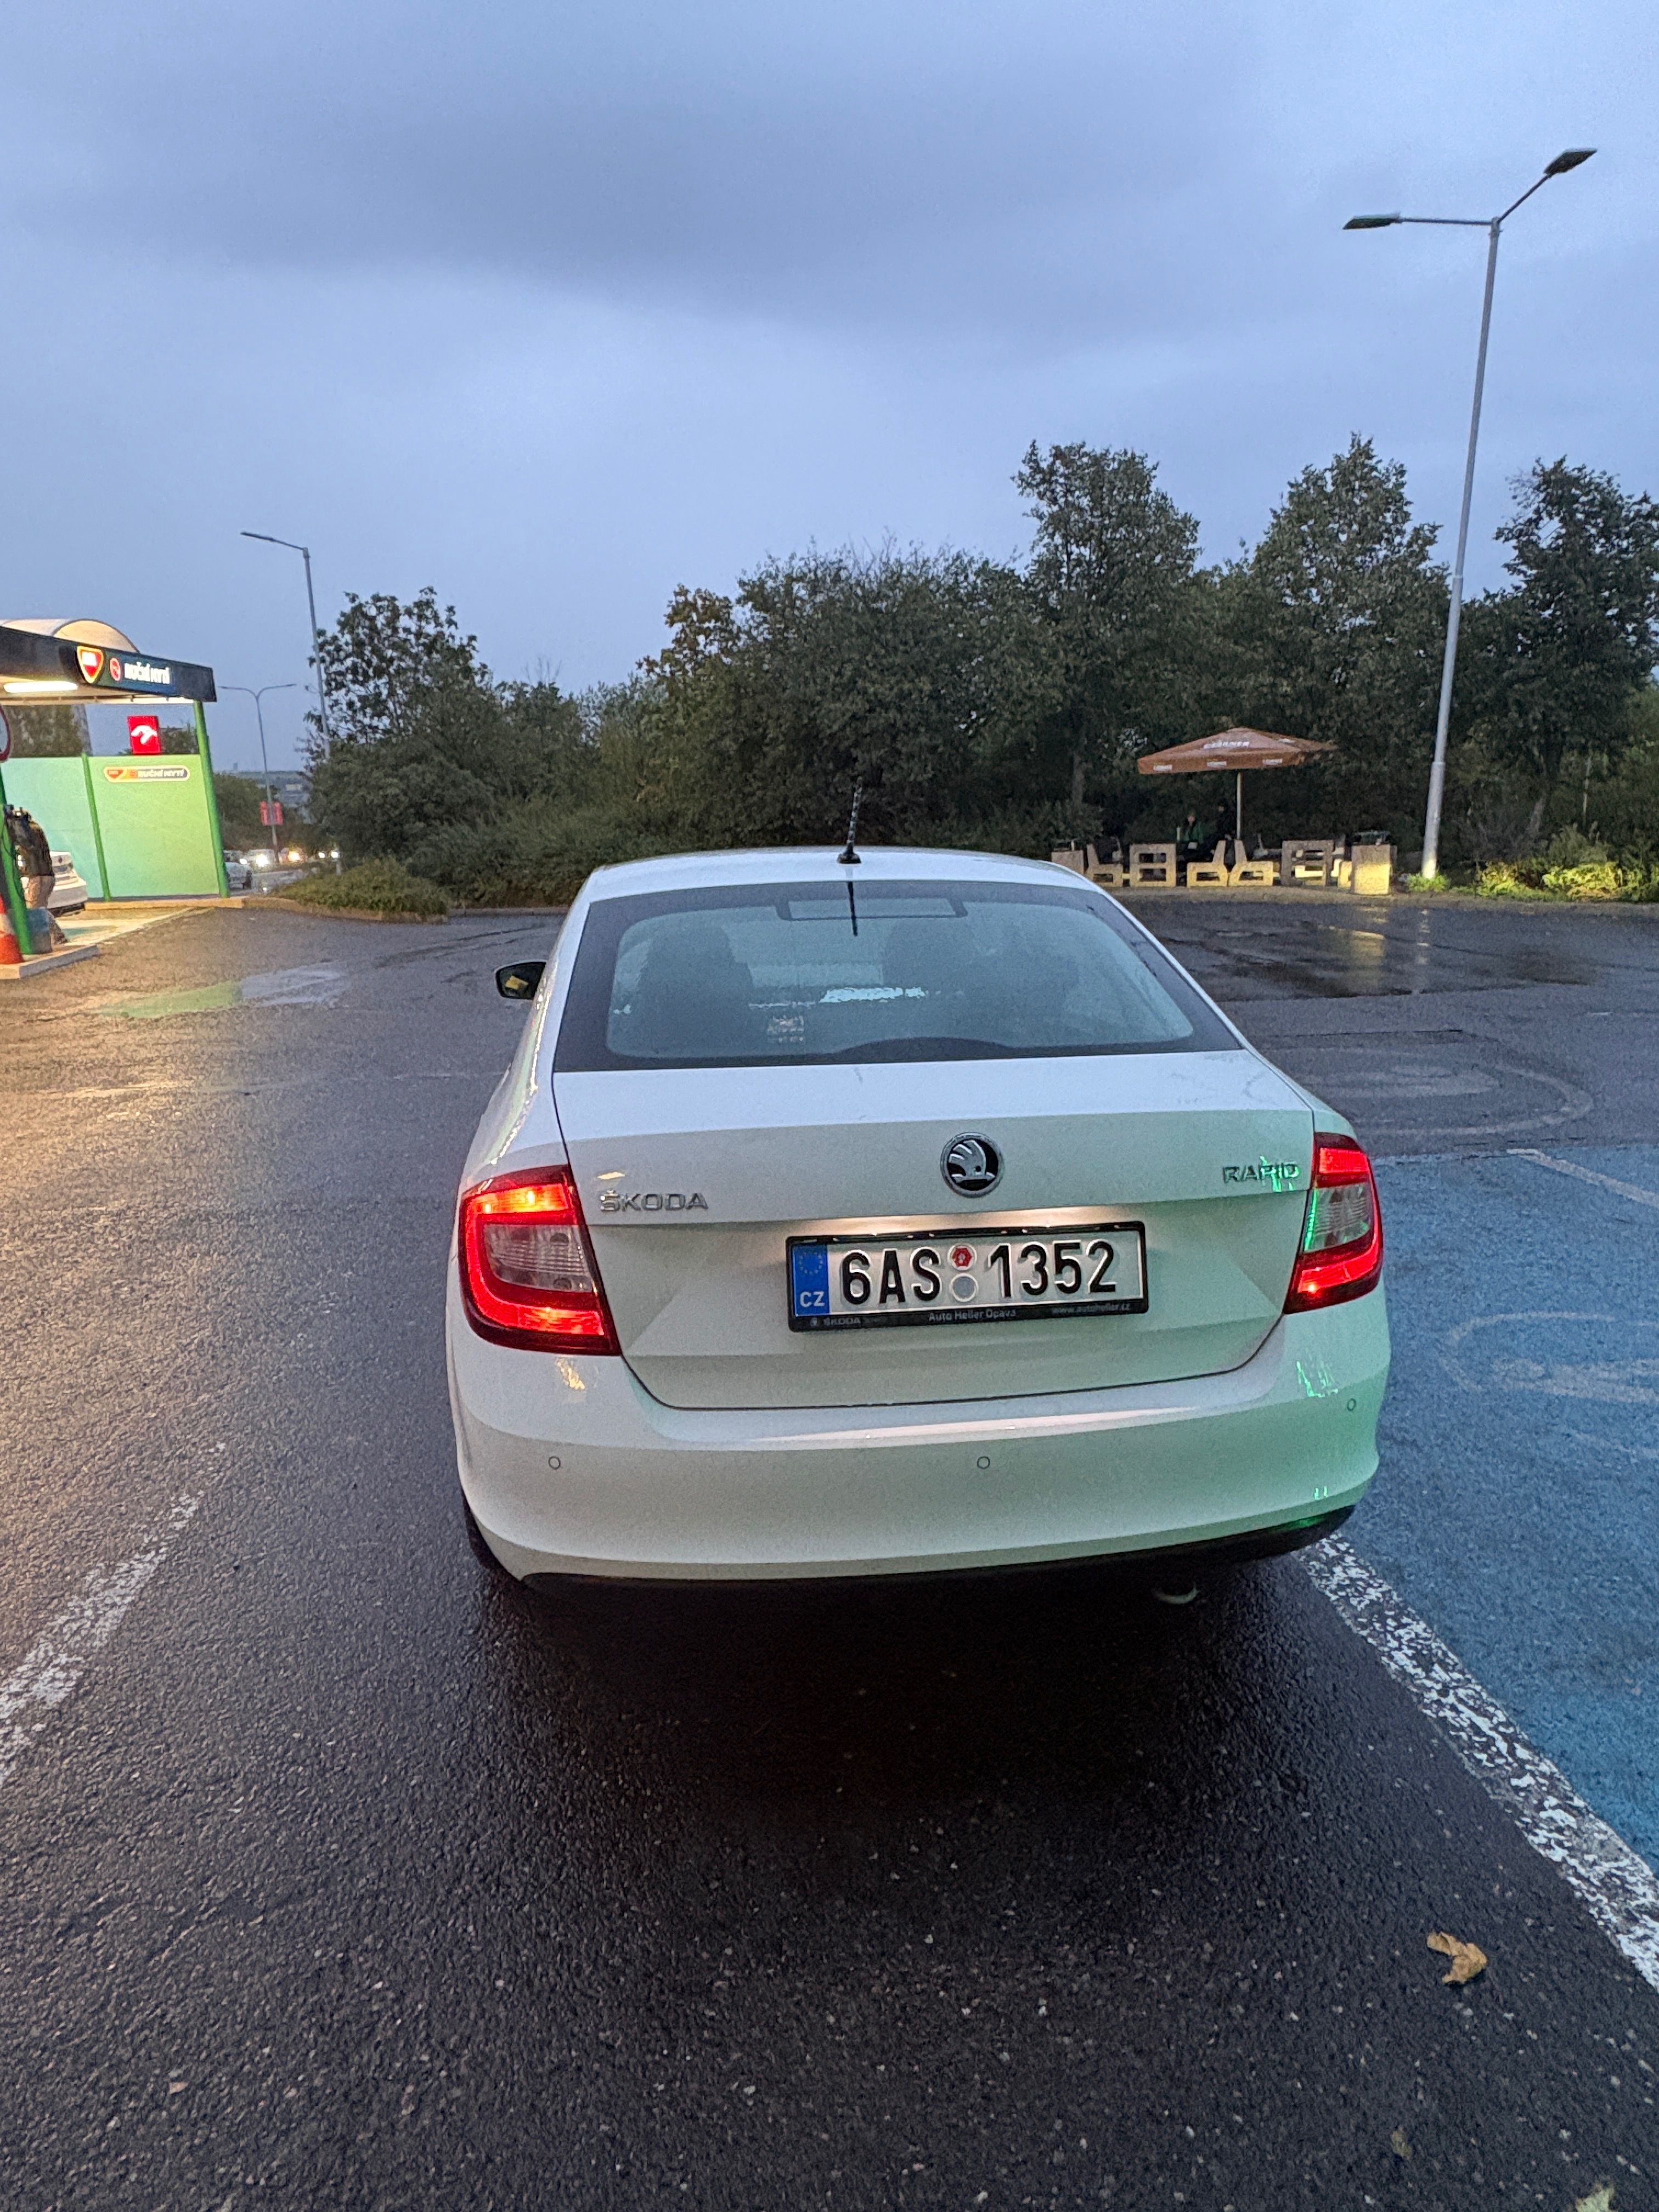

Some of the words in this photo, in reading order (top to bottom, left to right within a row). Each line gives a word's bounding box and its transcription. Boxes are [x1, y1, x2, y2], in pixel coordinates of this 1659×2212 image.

[1222, 1162, 1300, 1183] RAPID
[600, 1189, 708, 1212] ŠKODA
[842, 1247, 941, 1305] 6AS
[989, 1240, 1116, 1298] 1352
[800, 1291, 825, 1307] CZ
[929, 1311, 952, 1322] Auto
[955, 1309, 984, 1320] Heller
